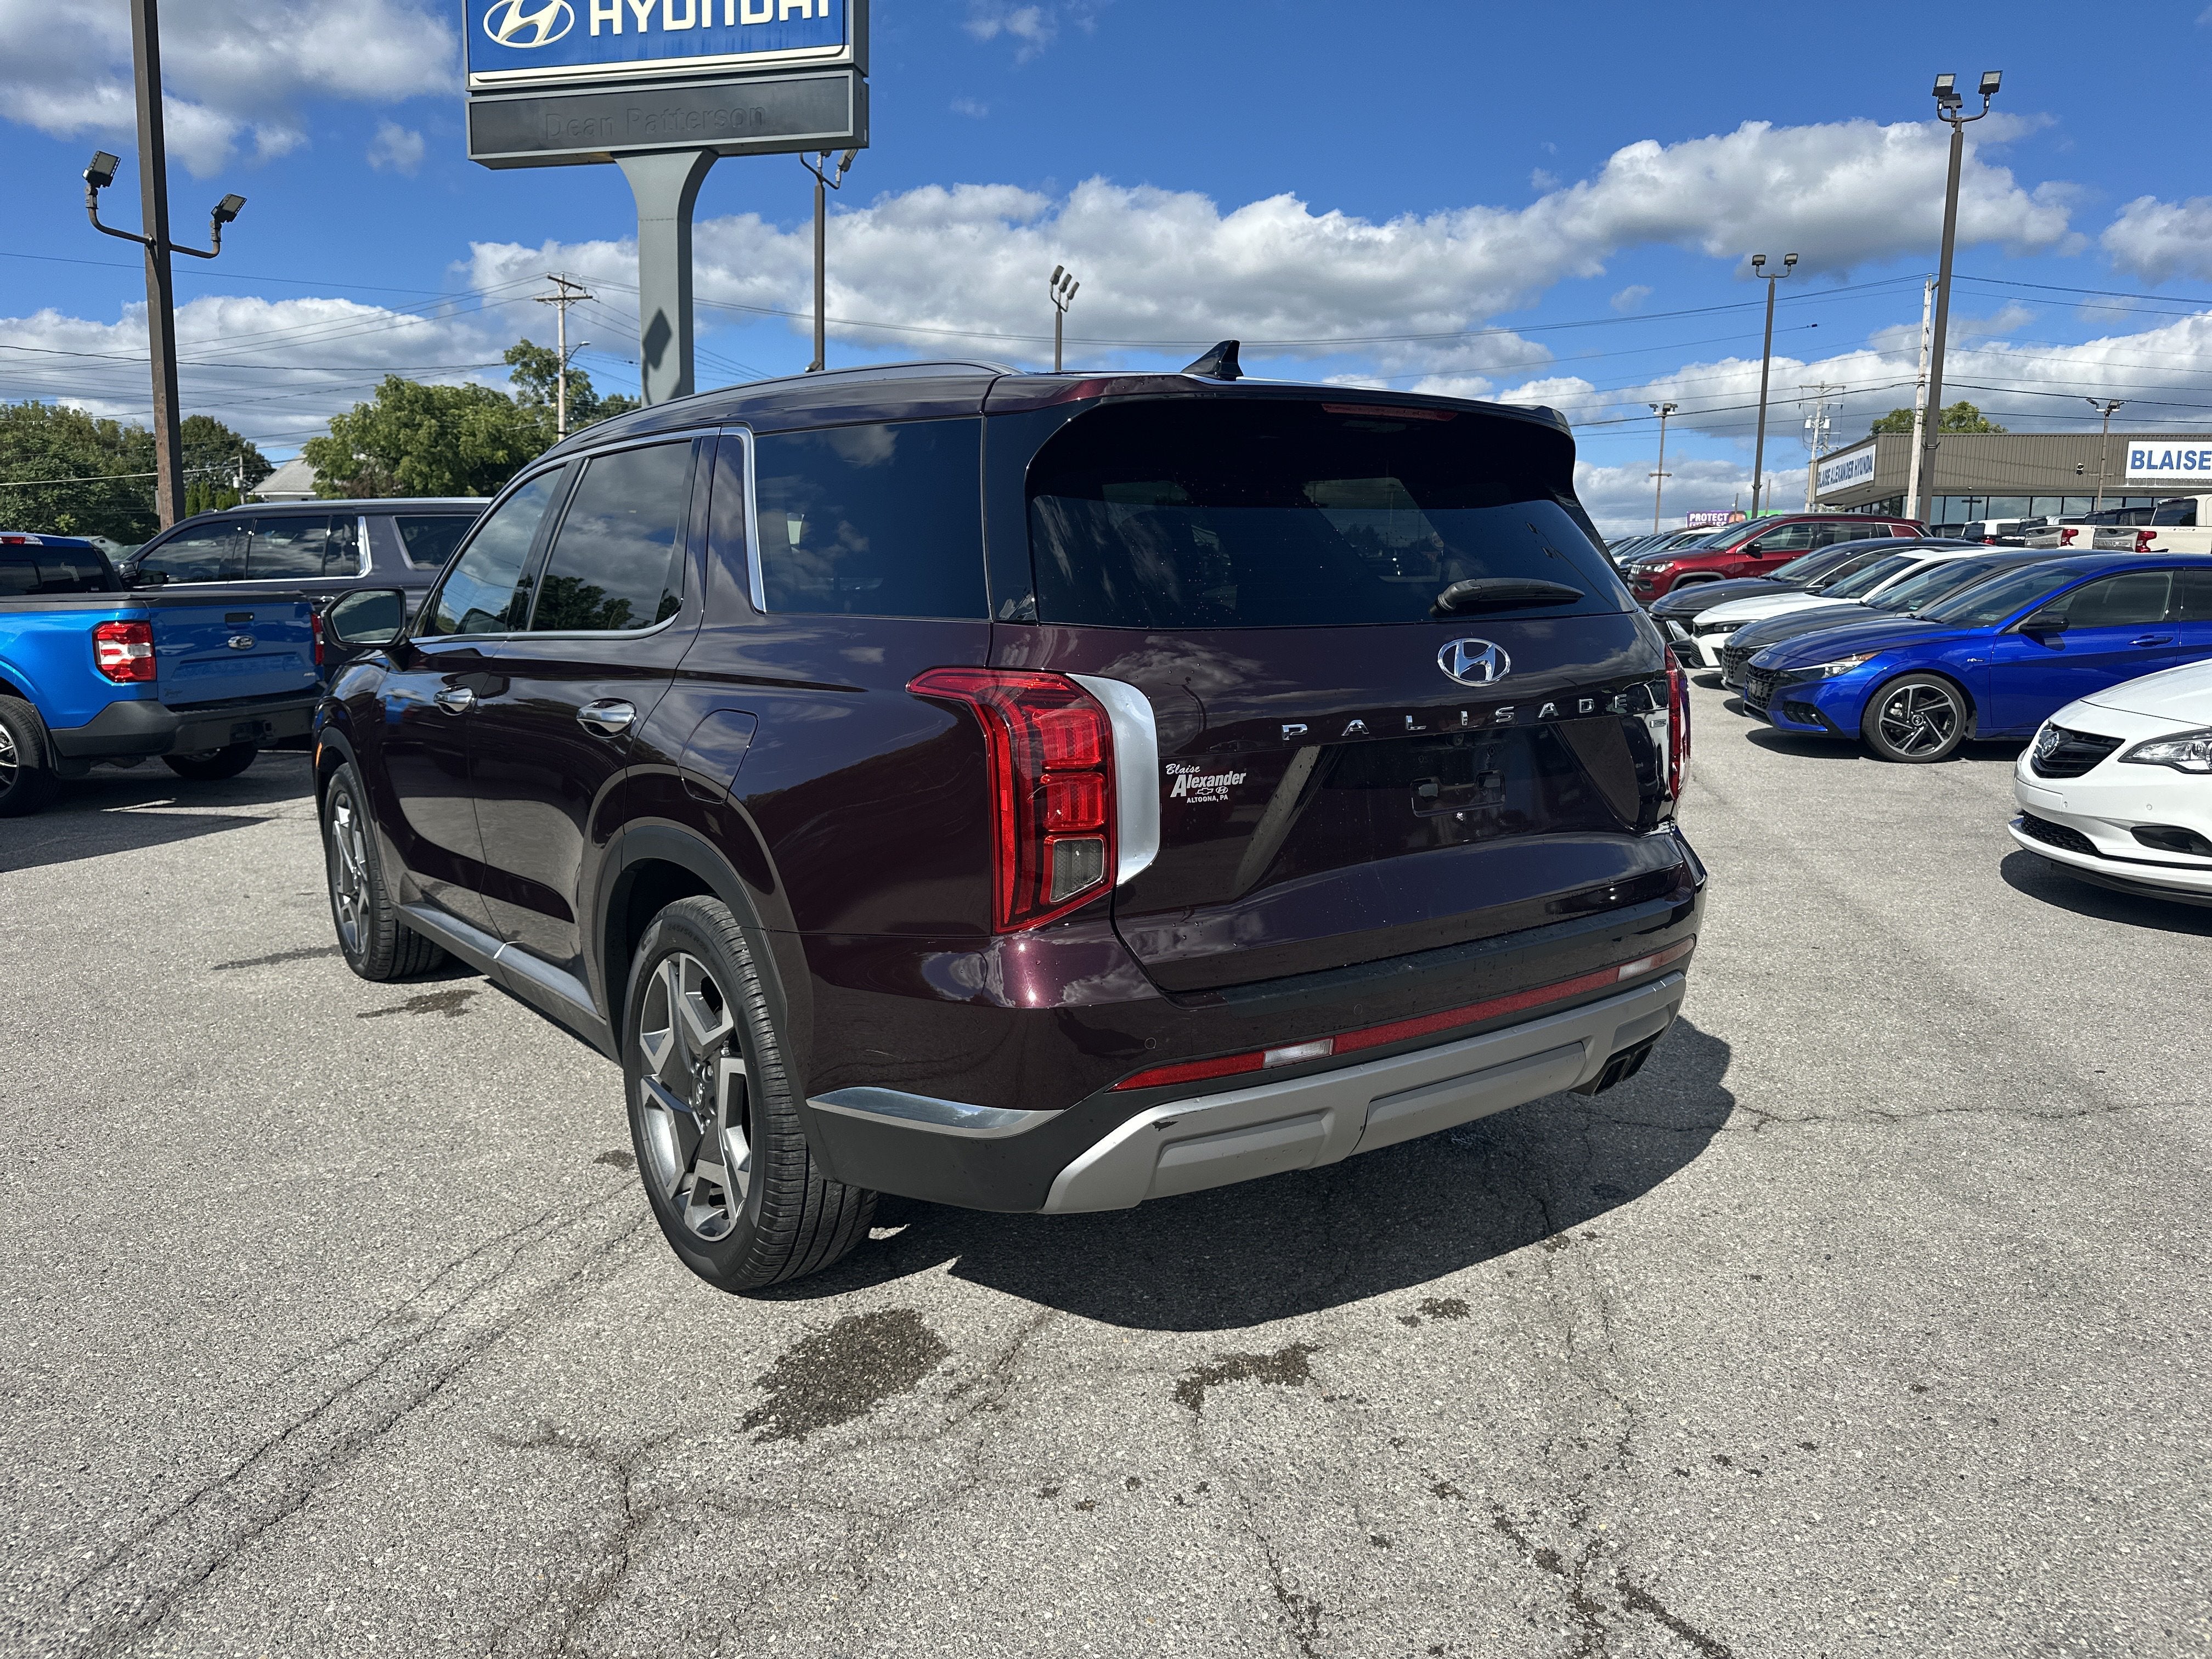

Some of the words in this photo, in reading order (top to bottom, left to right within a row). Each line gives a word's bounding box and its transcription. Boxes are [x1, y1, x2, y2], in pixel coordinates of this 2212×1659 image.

[546, 113, 614, 140] Dean
[627, 107, 765, 136] Patterson
[2130, 450, 2212, 471] BLAISE
[1689, 512, 1729, 522] PROTECT
[1281, 694, 1628, 741] PALISADE
[1165, 763, 1201, 775] Blaise
[1170, 770, 1247, 798] Alexander
[1186, 795, 1219, 804] ALTOONA,
